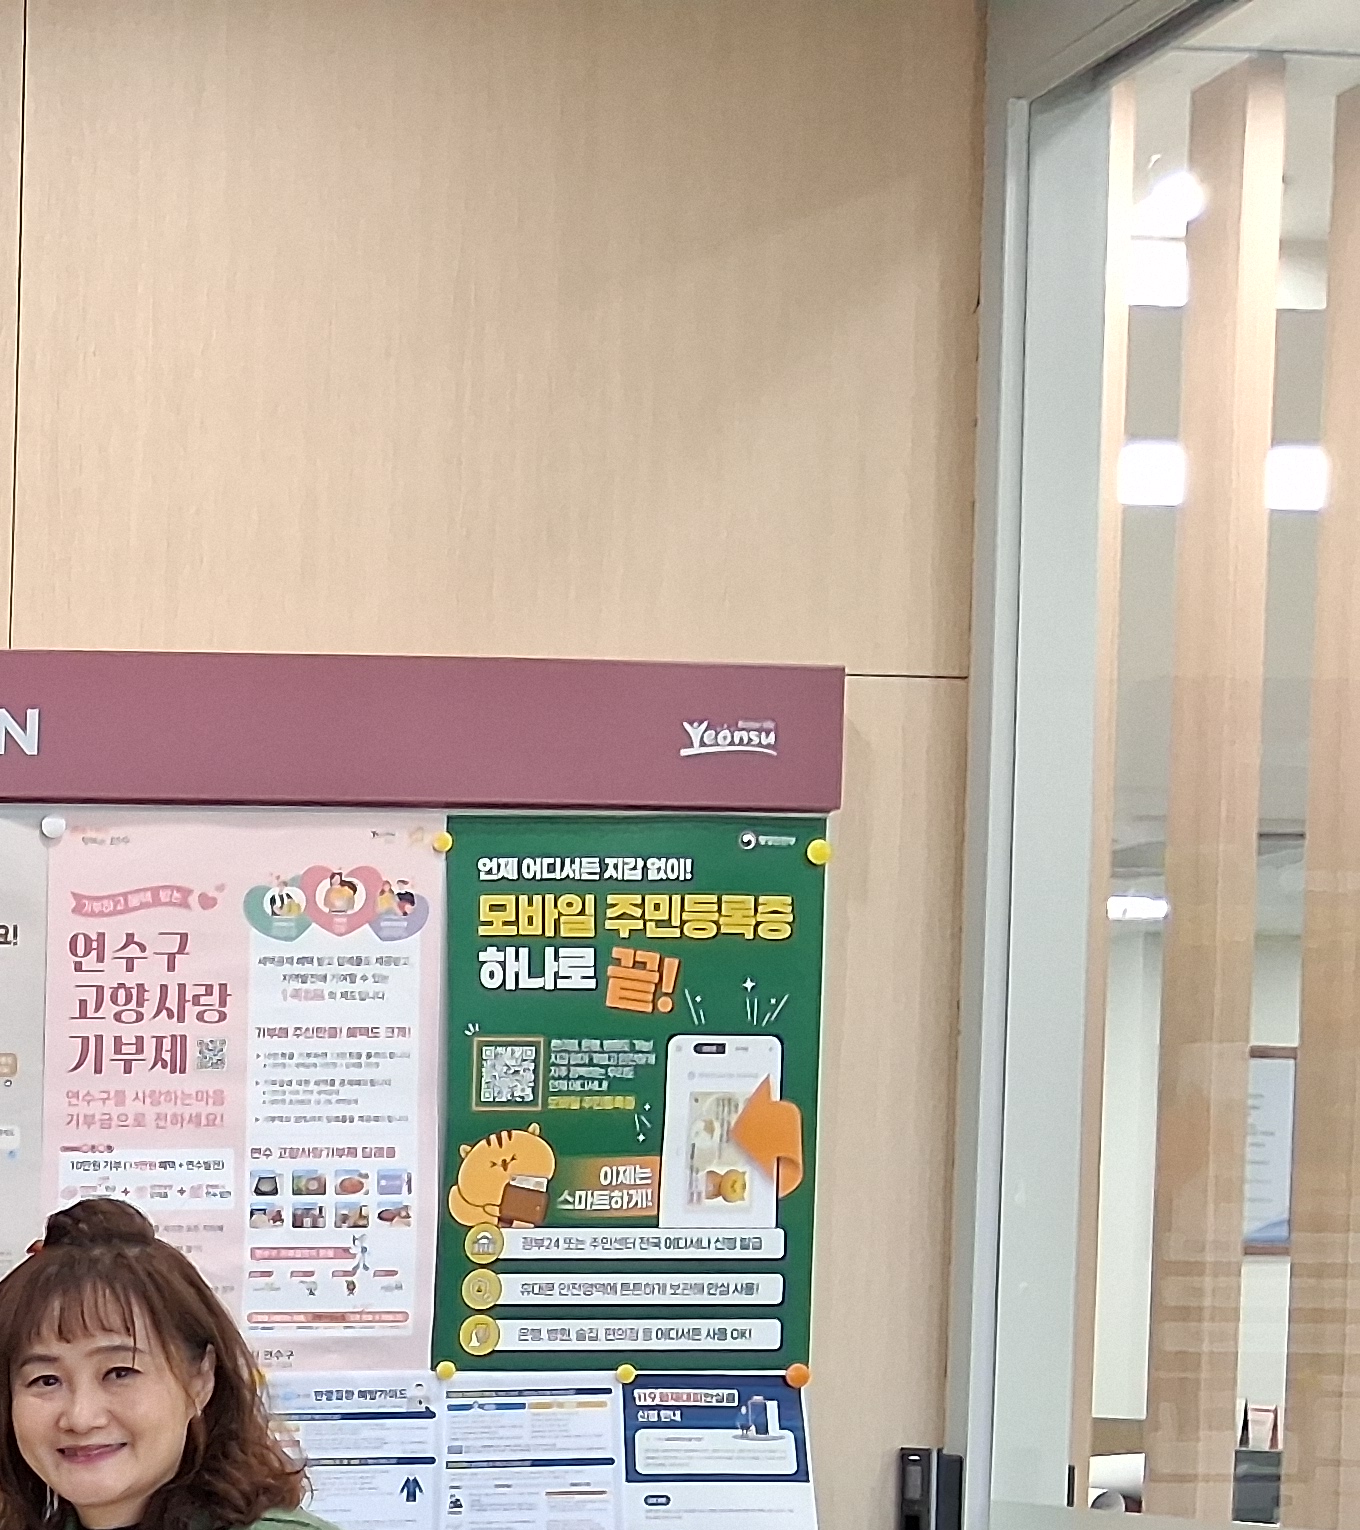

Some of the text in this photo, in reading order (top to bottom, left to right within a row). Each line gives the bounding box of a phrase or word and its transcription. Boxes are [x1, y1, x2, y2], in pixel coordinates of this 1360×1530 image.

[681, 720, 777, 753] Yeonsu
[477, 857, 693, 881] 언제 어디서든 지갑 없이!
[478, 894, 794, 940] 모바일 주민등록증
[69, 932, 189, 972] 연수구
[478, 946, 680, 1013] 하나로 끝!
[69, 983, 232, 1024] 고향사랑
[68, 1034, 188, 1075] 기부제
[600, 1165, 652, 1186] 이제는
[557, 1188, 653, 1209] 스마트하게!
